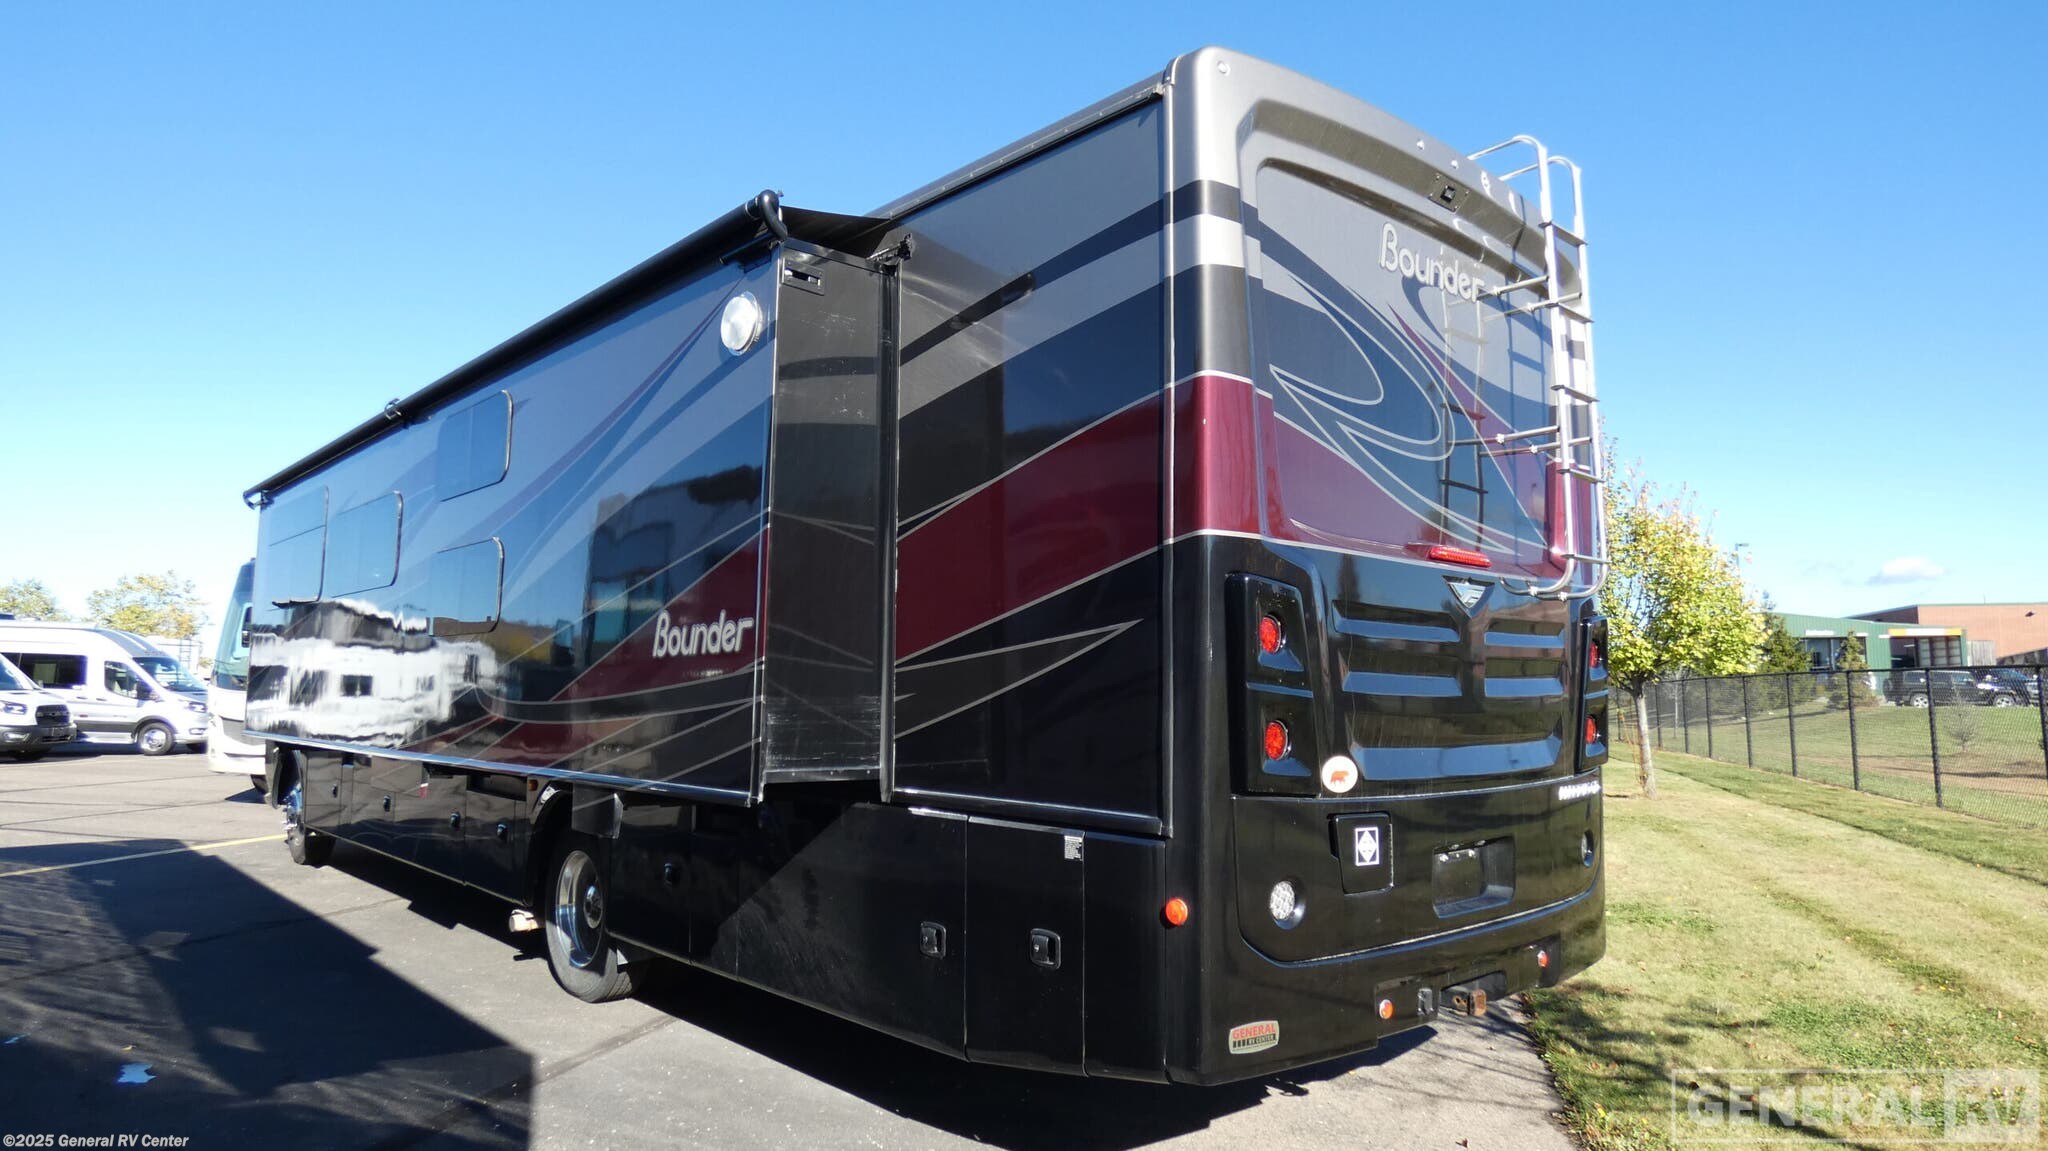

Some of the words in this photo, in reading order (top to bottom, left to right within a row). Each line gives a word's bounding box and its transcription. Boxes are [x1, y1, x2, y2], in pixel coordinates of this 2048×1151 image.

[1380, 222, 1485, 302] Bounder
[652, 609, 754, 657] Bounder
[1232, 1023, 1276, 1040] GENERAL
